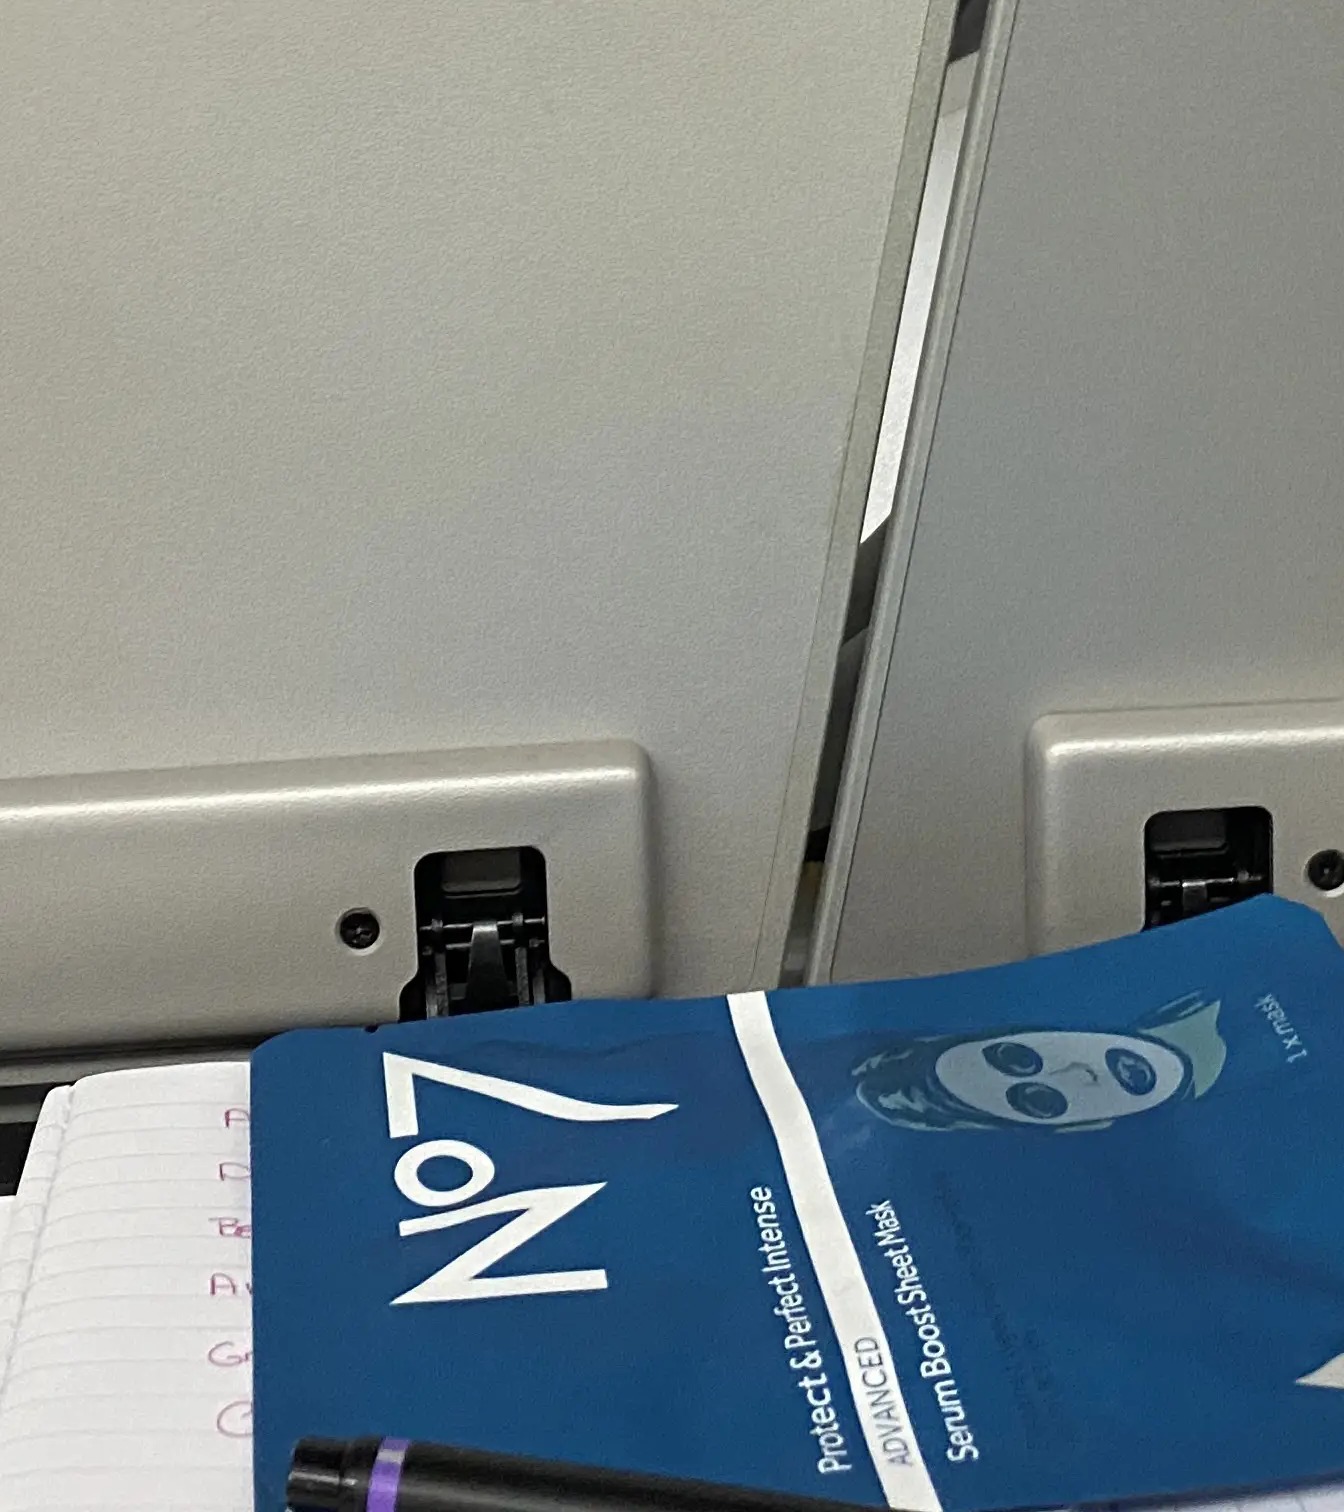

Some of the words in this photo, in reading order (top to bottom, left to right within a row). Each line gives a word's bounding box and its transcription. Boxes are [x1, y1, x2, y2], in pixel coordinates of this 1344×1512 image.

[1253, 992, 1295, 1035] mask
[1281, 1033, 1304, 1050] x
[1285, 1047, 1308, 1064] 1
[382, 1050, 680, 1306] No7
[750, 1185, 792, 1273] Intense
[864, 1199, 907, 1248] Mask
[767, 1272, 819, 1351] Perfect
[883, 1242, 929, 1308] Sheet
[789, 1350, 823, 1370] &
[905, 1303, 952, 1380] Boost
[797, 1371, 853, 1475] Protect
[853, 1336, 914, 1468] ADVANCED
[933, 1378, 980, 1463] Serum
